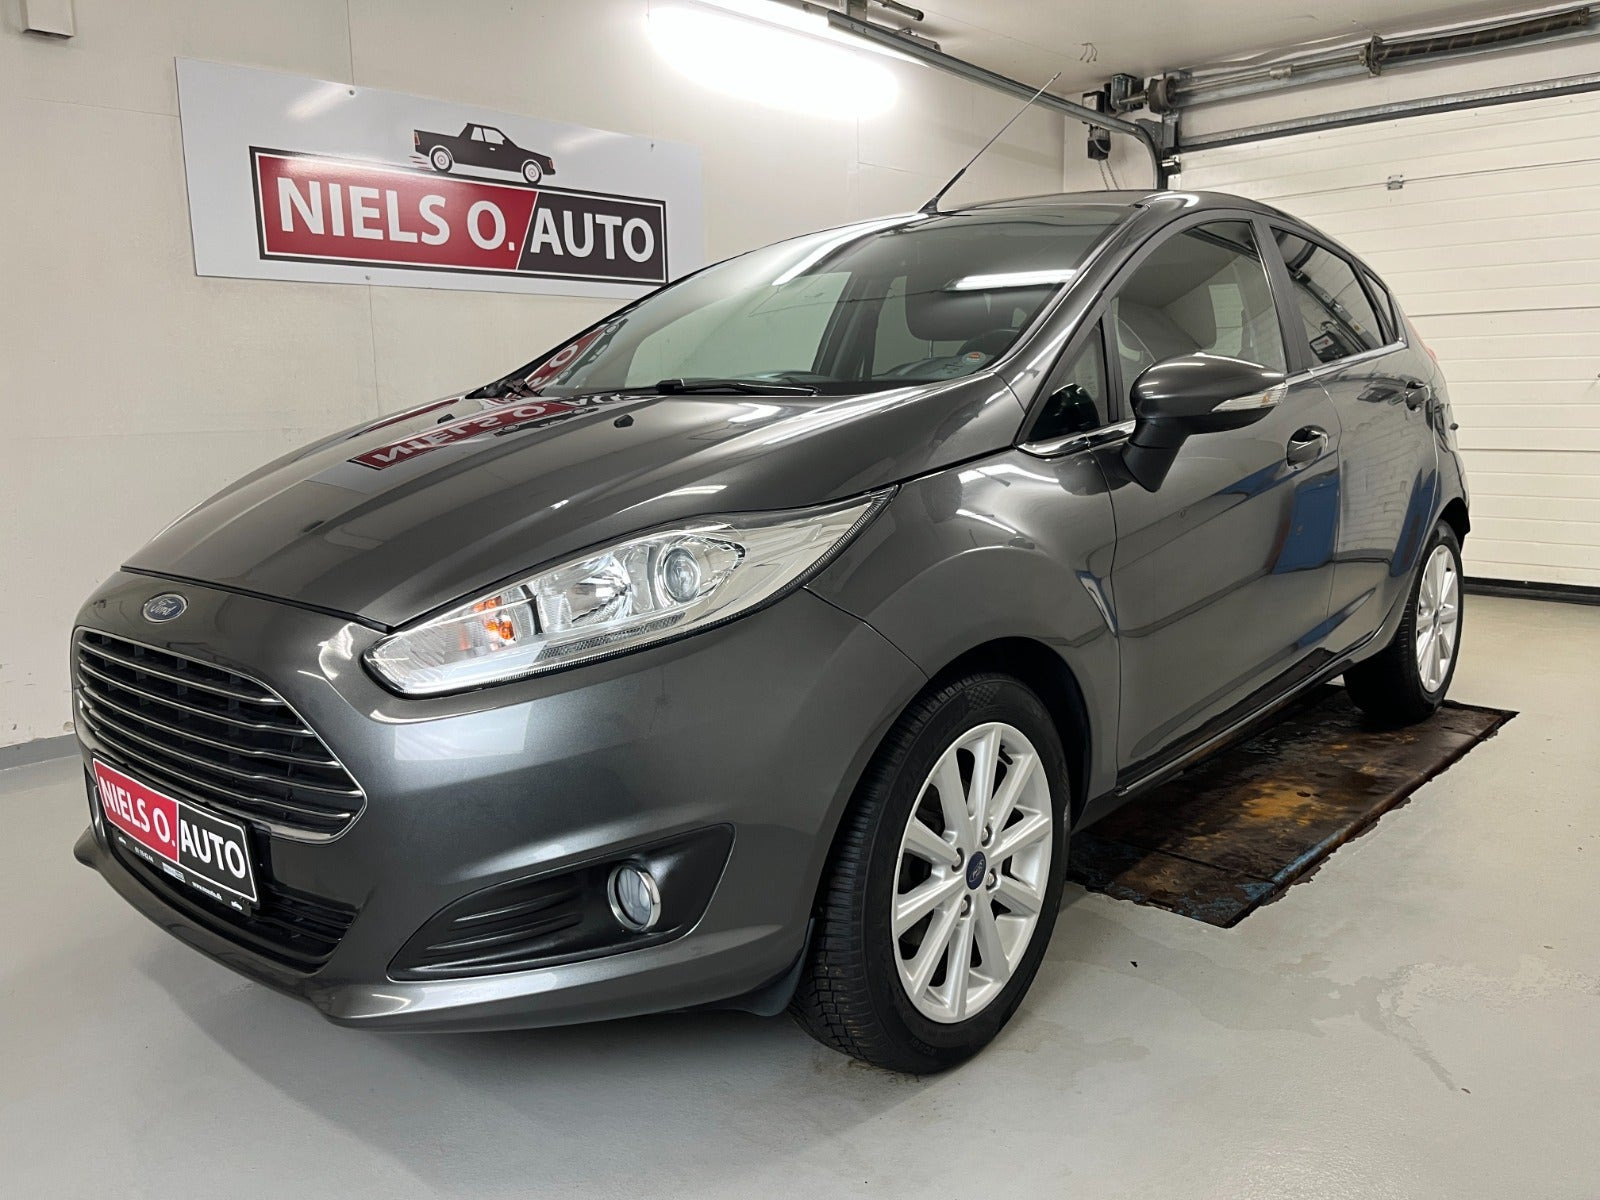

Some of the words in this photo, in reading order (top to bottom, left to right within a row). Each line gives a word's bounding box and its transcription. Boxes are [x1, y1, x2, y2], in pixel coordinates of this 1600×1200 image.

[276, 176, 451, 246] NIELS
[466, 200, 516, 252] O.
[530, 208, 655, 262] AUTO
[99, 776, 151, 833] NIELS
[153, 807, 176, 847] O.
[180, 819, 246, 879] AUTO
